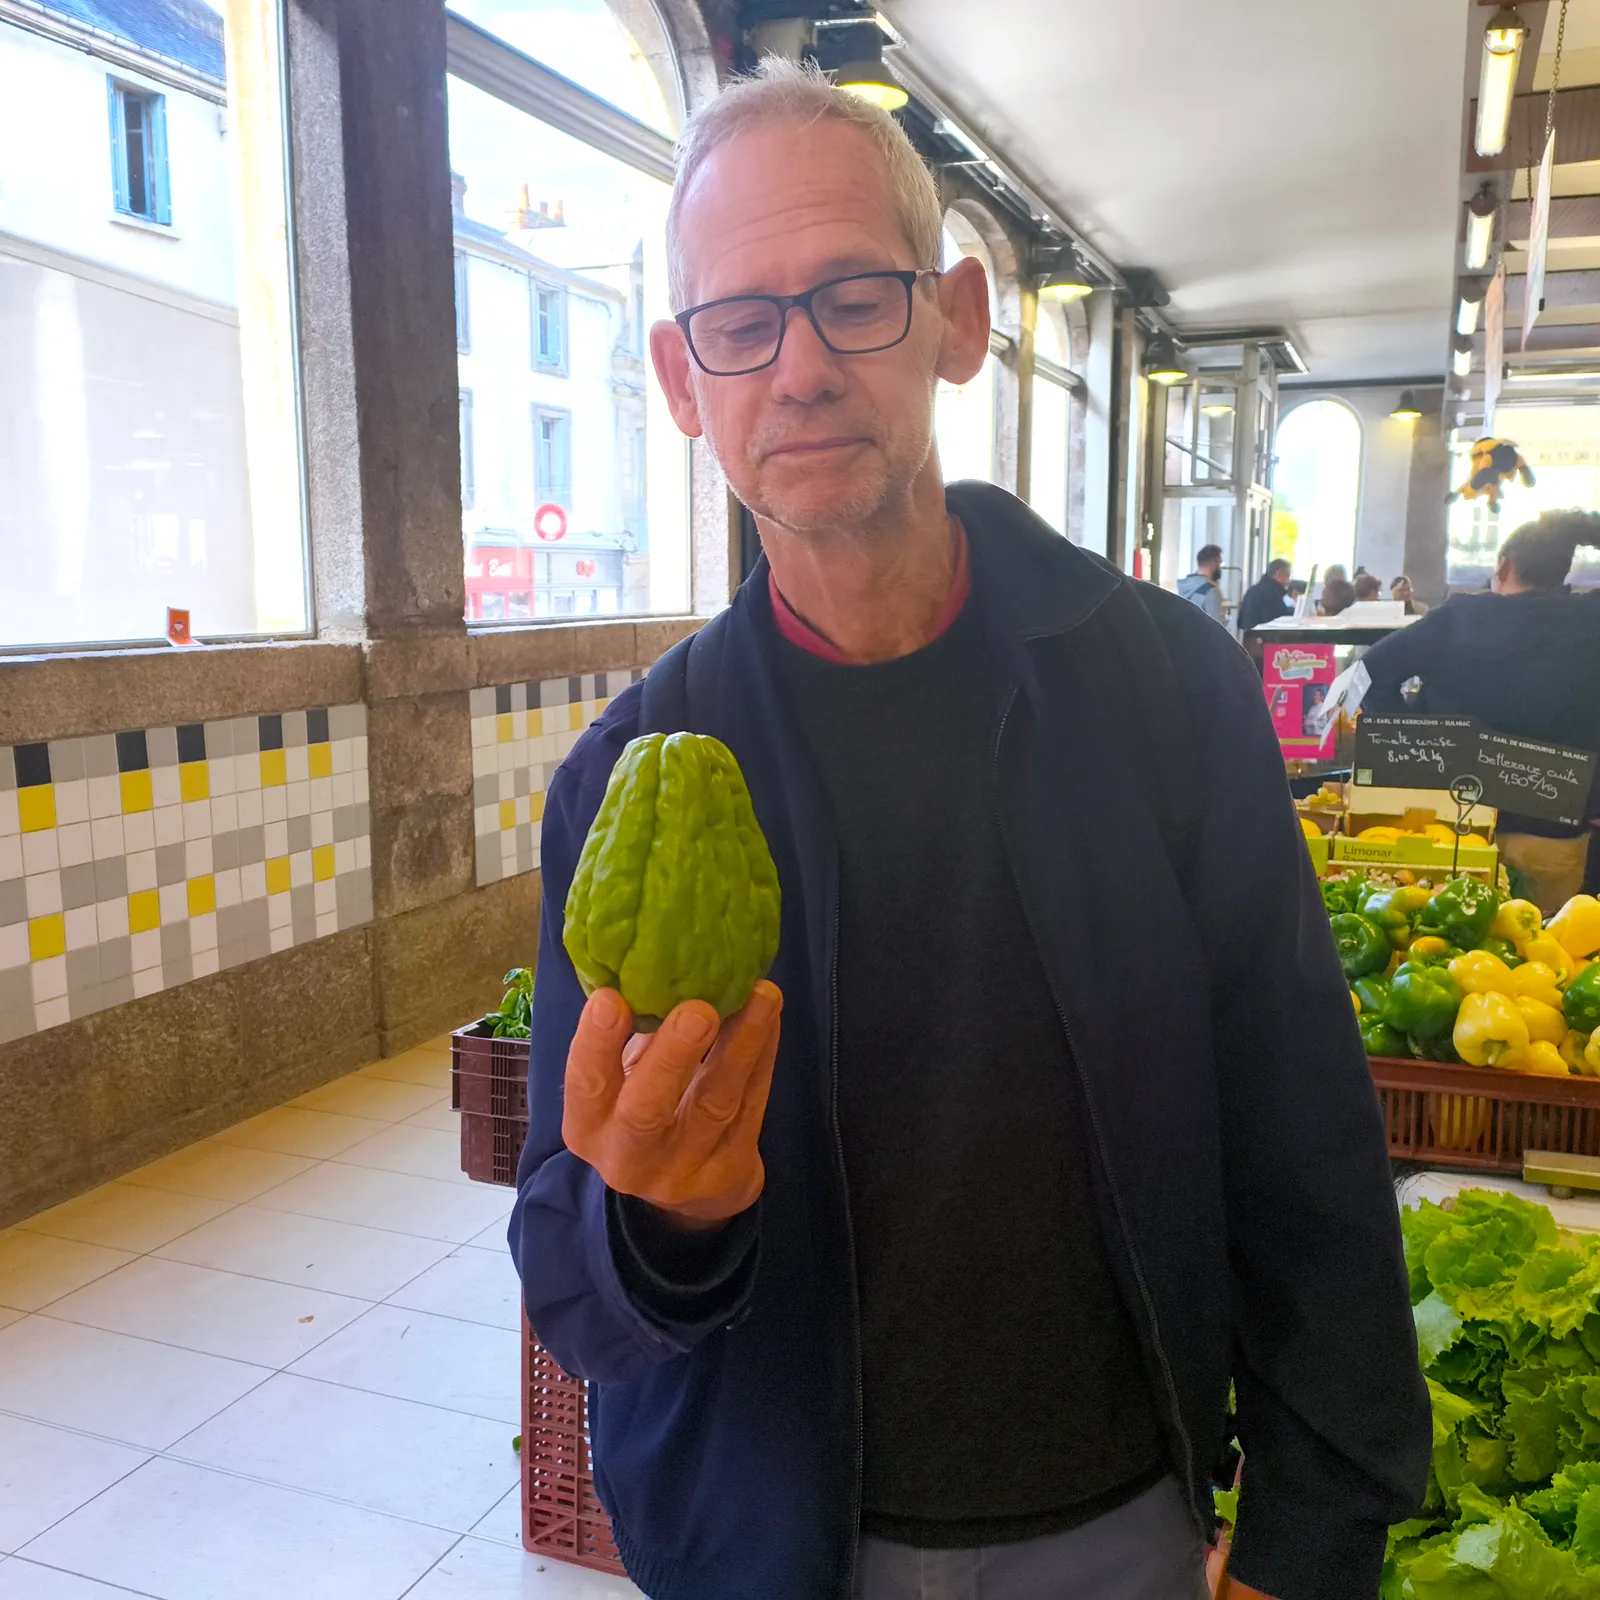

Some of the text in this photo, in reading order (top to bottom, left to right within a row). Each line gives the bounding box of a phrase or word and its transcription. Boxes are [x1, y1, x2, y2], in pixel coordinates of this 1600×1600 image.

[1368, 731, 1411, 745] Tomate
[1493, 735, 1508, 745] EARL
[1344, 845, 1393, 857] Limonar
